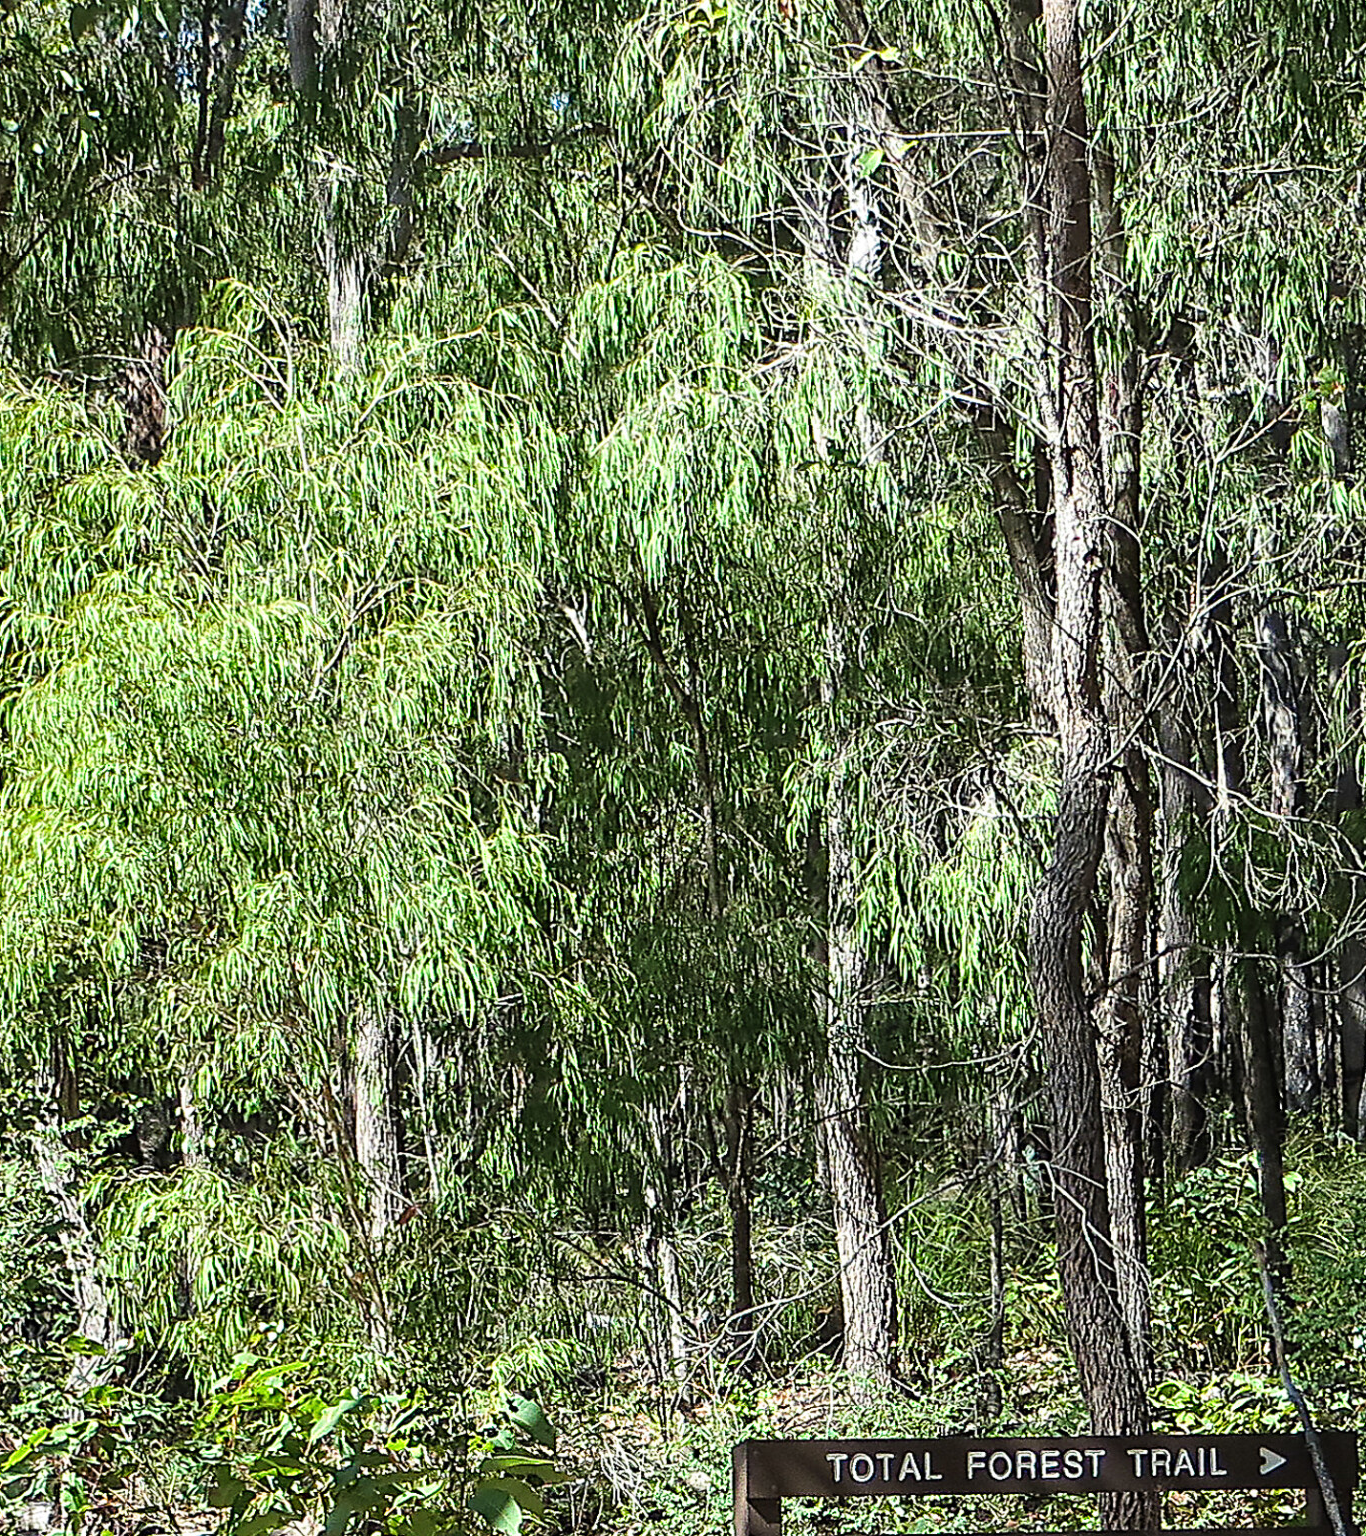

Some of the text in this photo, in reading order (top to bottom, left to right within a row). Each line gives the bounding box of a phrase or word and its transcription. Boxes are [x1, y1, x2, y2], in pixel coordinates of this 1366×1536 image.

[826, 1447, 1228, 1482] TOTAL FOREST TRAIL
